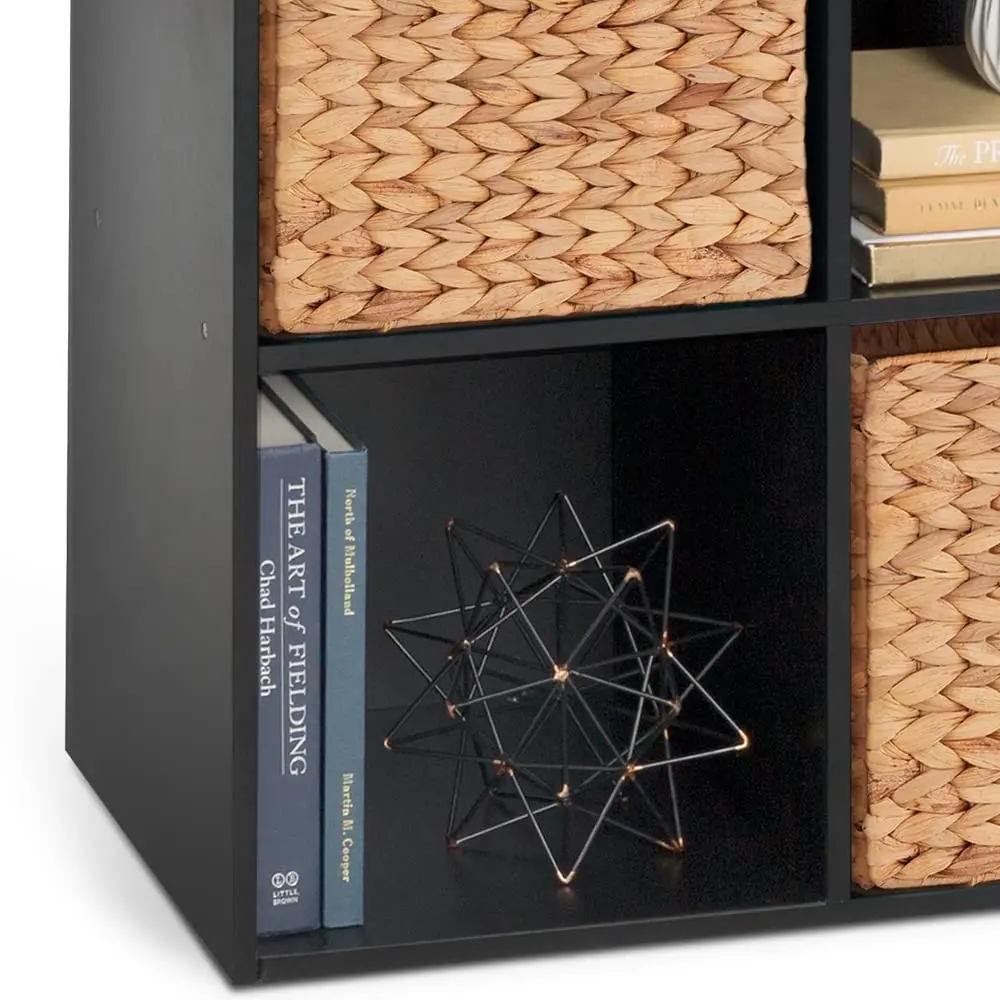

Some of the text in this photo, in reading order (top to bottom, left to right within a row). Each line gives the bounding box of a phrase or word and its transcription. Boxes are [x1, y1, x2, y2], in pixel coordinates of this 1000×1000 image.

[933, 144, 967, 167] The
[343, 488, 357, 616] North of Mulholland
[259, 560, 277, 697] Chad Harbach
[283, 477, 307, 777] THE ART of FIELDING
[342, 773, 354, 817] Martin
[340, 837, 354, 883] Cooper
